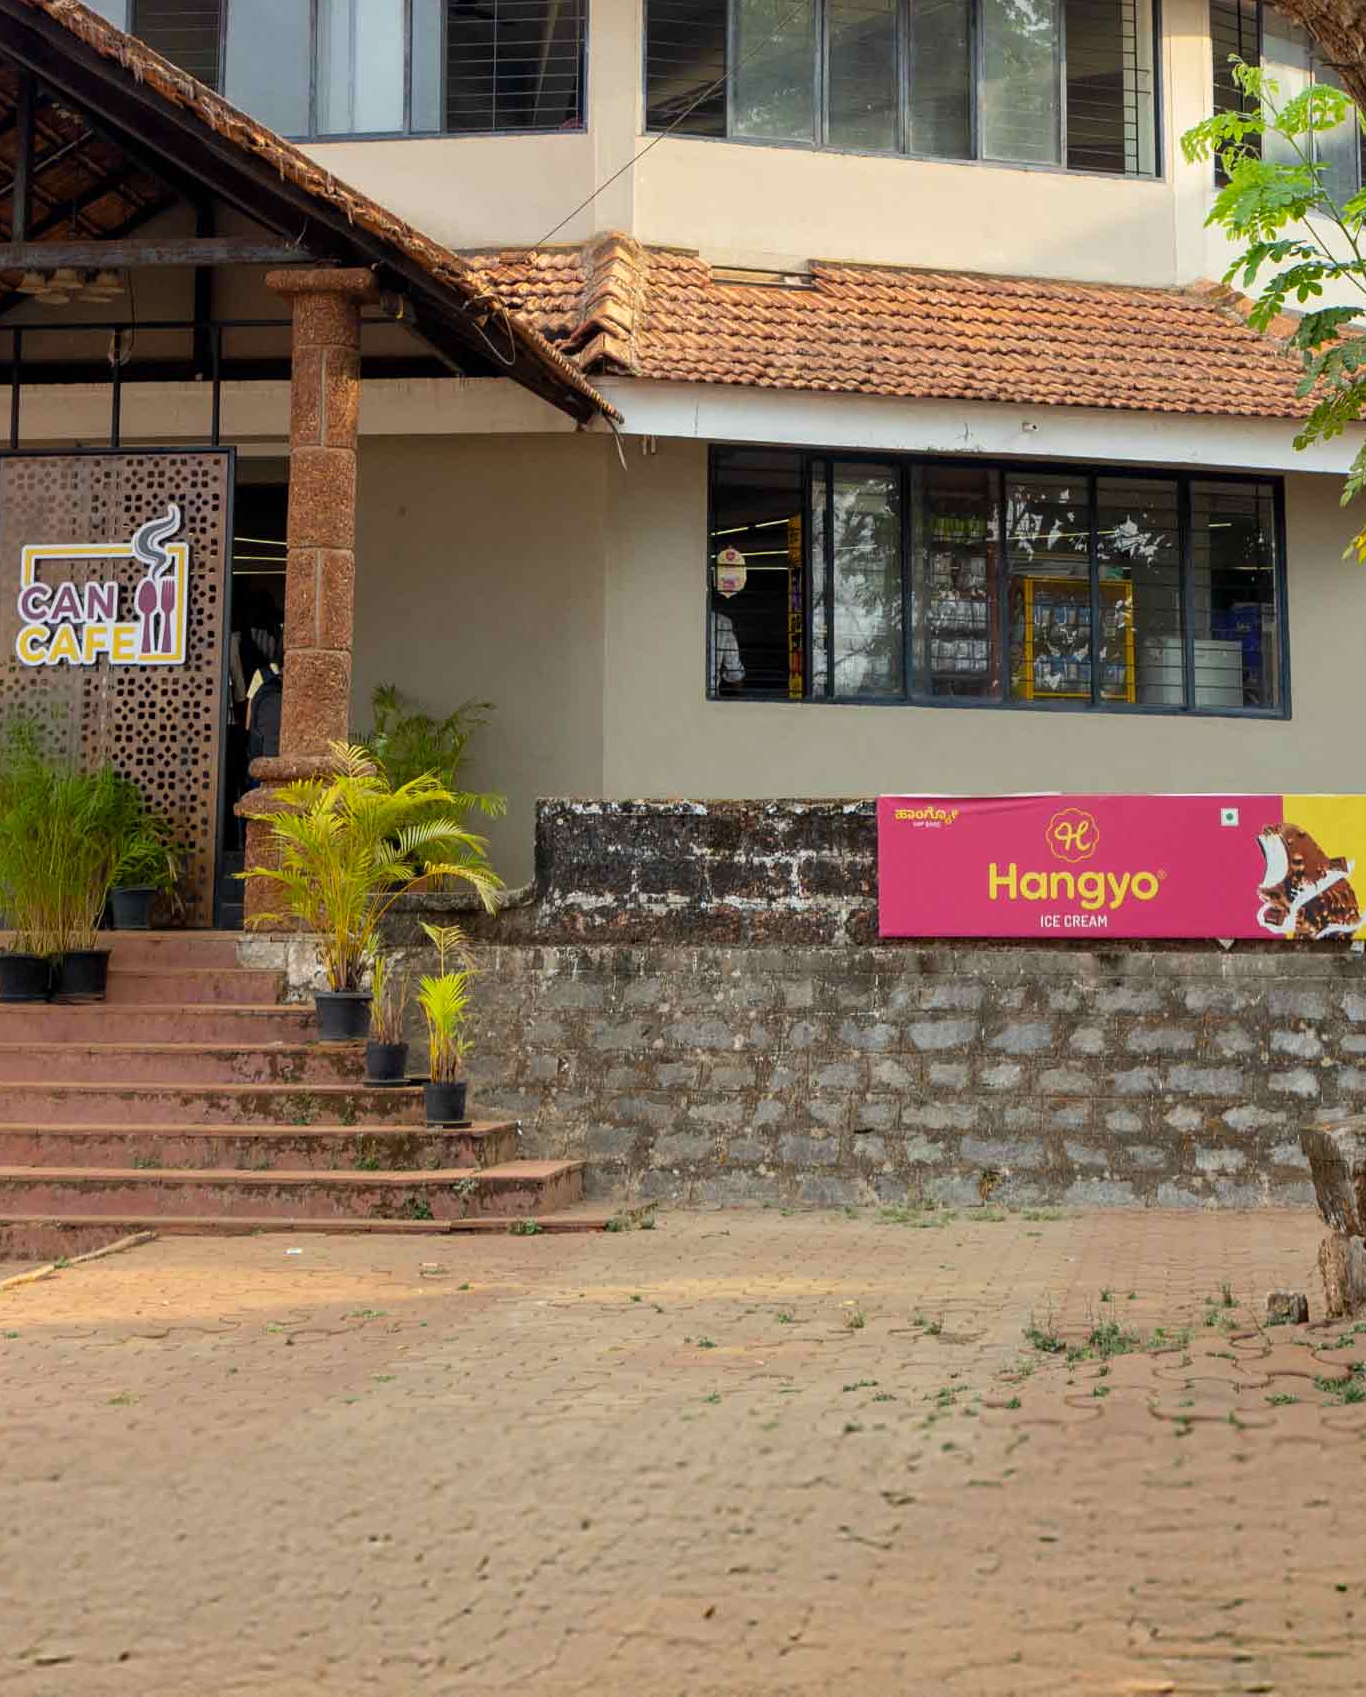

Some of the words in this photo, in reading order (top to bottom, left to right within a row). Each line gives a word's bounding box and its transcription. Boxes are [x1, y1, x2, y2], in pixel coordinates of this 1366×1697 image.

[19, 582, 117, 623] CAN
[17, 624, 137, 664] CAFE
[988, 862, 1160, 910] Hangyo
[1040, 914, 1060, 928] ICE
[1064, 914, 1108, 928] CREAM
